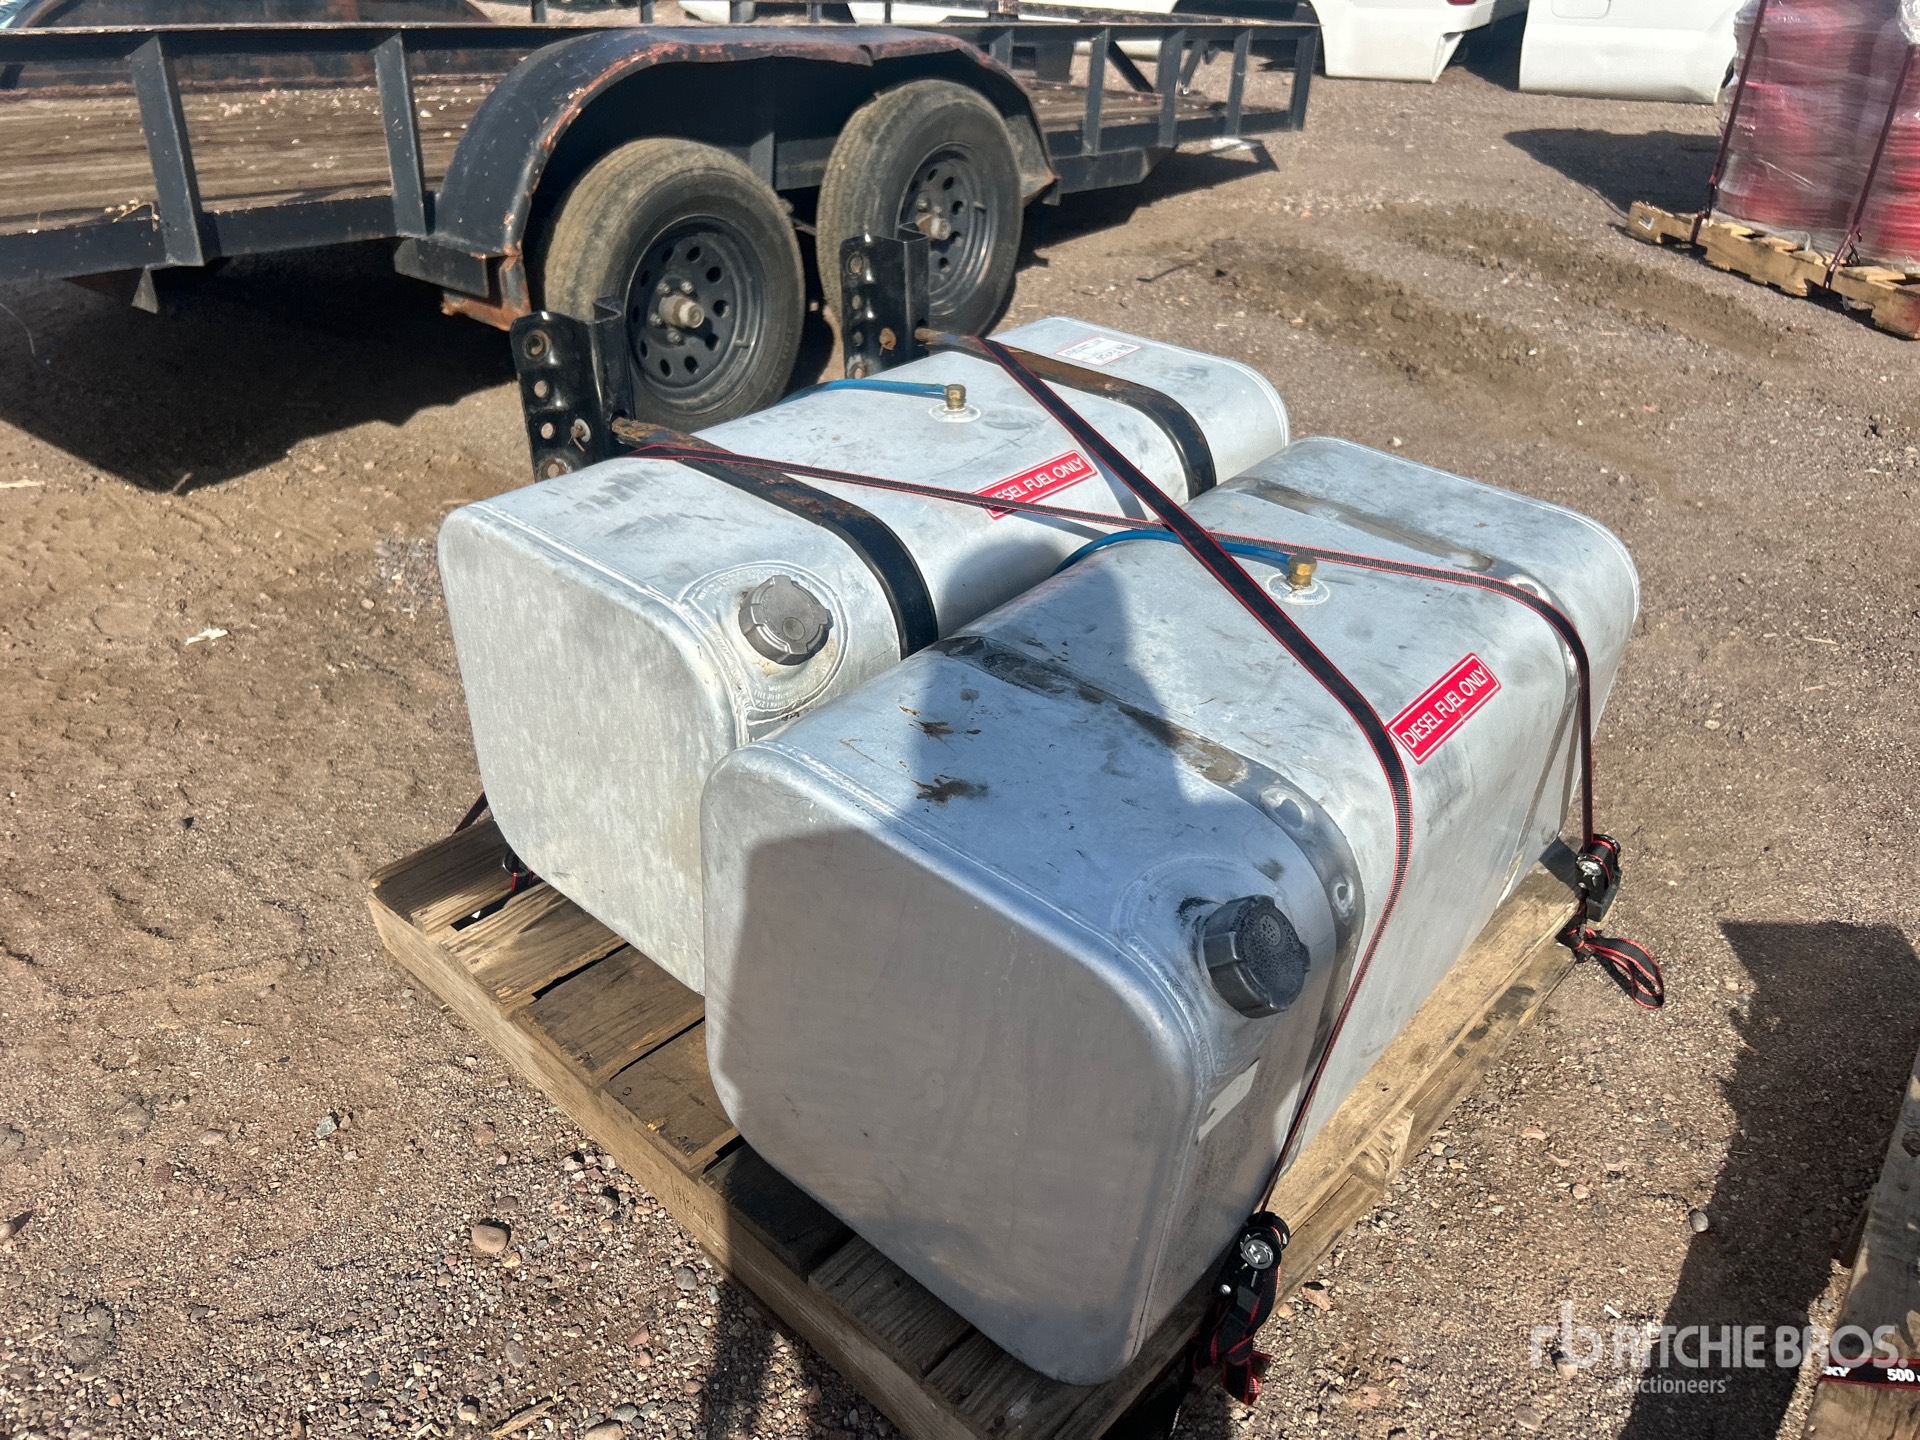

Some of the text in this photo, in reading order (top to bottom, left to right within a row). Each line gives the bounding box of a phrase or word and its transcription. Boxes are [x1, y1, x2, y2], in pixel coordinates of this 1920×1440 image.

[990, 457, 1085, 501] ESEL FUEL ONLY
[1400, 665, 1489, 749] DIESEL FUEL ONLY
[1887, 1368, 1915, 1382] 500
